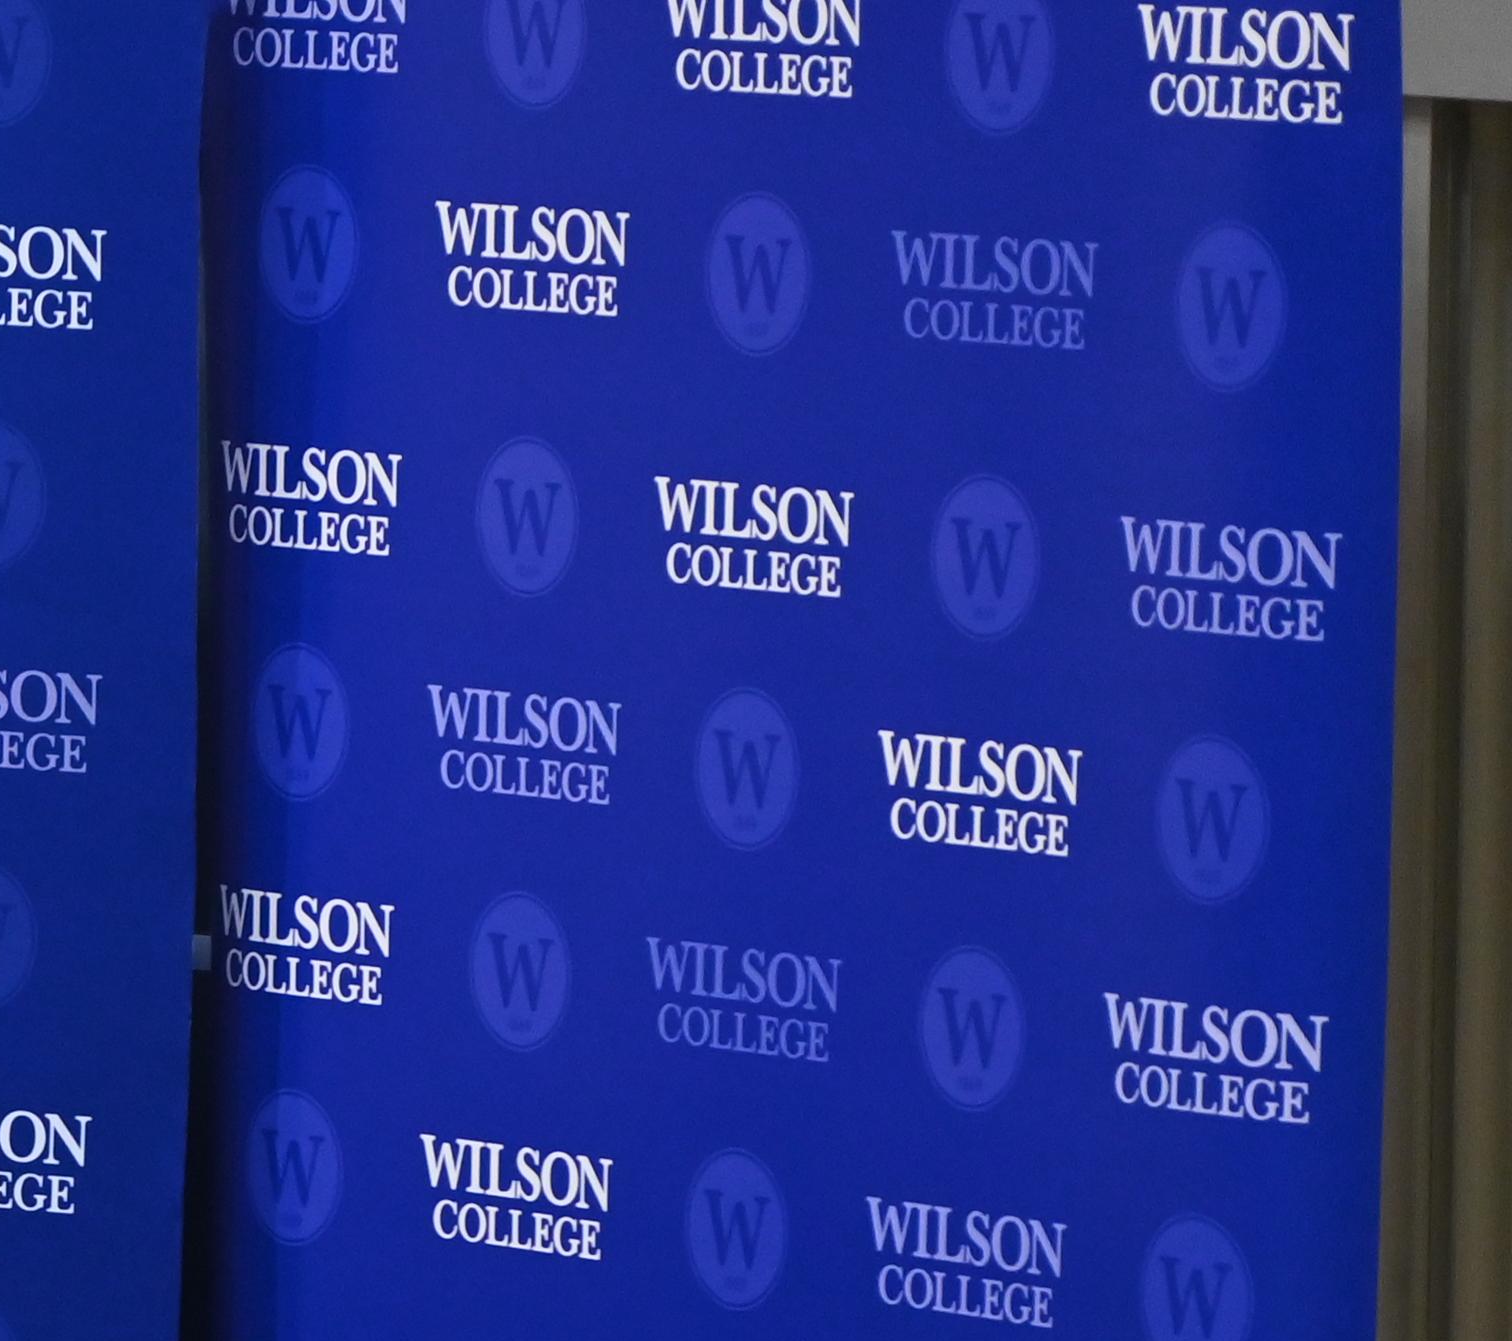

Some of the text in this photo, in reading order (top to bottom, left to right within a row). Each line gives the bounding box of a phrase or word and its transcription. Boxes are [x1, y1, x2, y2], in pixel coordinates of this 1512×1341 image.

[233, 28, 399, 73] COLLEGE
[1138, 4, 1354, 71] WILSON
[676, 48, 852, 98] COLLEGE
[1150, 72, 1342, 124] COLLEGE
[435, 201, 630, 266] WILSON
[892, 231, 1098, 299] WILSON
[448, 266, 617, 317] COLLEGE
[724, 235, 792, 313] W
[904, 298, 1085, 350] COLLEGE
[222, 440, 402, 507] WILSON
[229, 504, 390, 556] COLLEGE
[495, 478, 562, 557] W
[654, 476, 855, 547] WILSON
[666, 542, 841, 598] COLLEGE
[1121, 516, 1342, 588] WILSON
[1132, 586, 1323, 641] COLLEGE
[428, 685, 621, 755] WILSON
[441, 750, 609, 804] COLLEGE
[878, 730, 1083, 805] WILSON
[890, 798, 1068, 857] COLLEGE
[220, 884, 395, 958] WILSON
[226, 949, 382, 1006] COLLEGE
[648, 938, 840, 1009] WILSON
[660, 1004, 825, 1060] COLLEGE
[1104, 992, 1329, 1072] WILSON
[1115, 1062, 1309, 1124] COLLEGE
[419, 1134, 613, 1212] WILSON
[433, 1199, 601, 1260] COLLEGE
[867, 1197, 1066, 1277] WILSON
[879, 1265, 1052, 1328] COLLEGE
